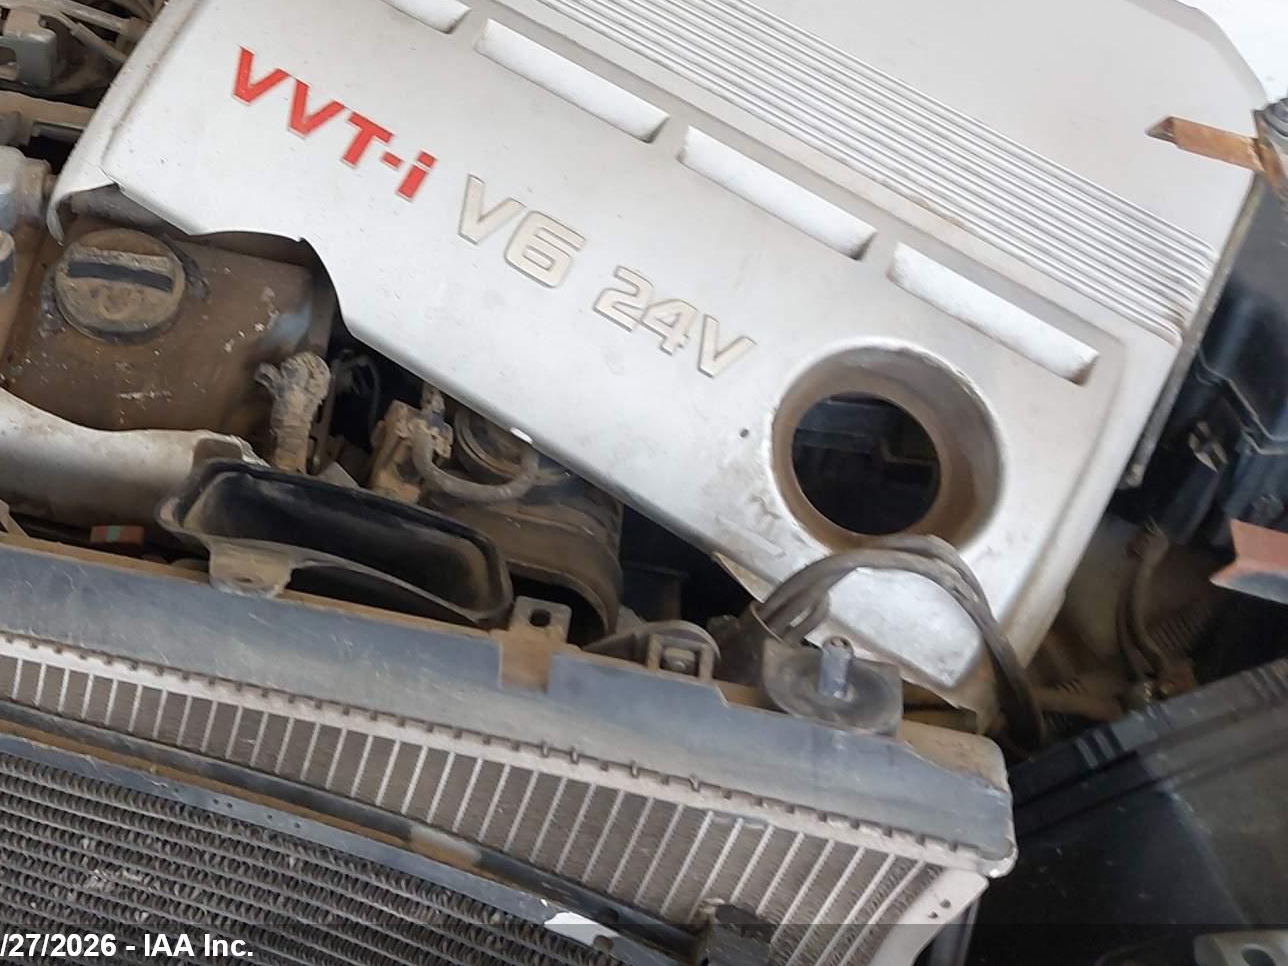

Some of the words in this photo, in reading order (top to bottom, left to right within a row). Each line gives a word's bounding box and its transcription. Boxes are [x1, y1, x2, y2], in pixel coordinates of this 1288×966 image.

[232, 45, 437, 201] VVT-i
[457, 173, 586, 289] V6
[592, 265, 758, 379] 24V
